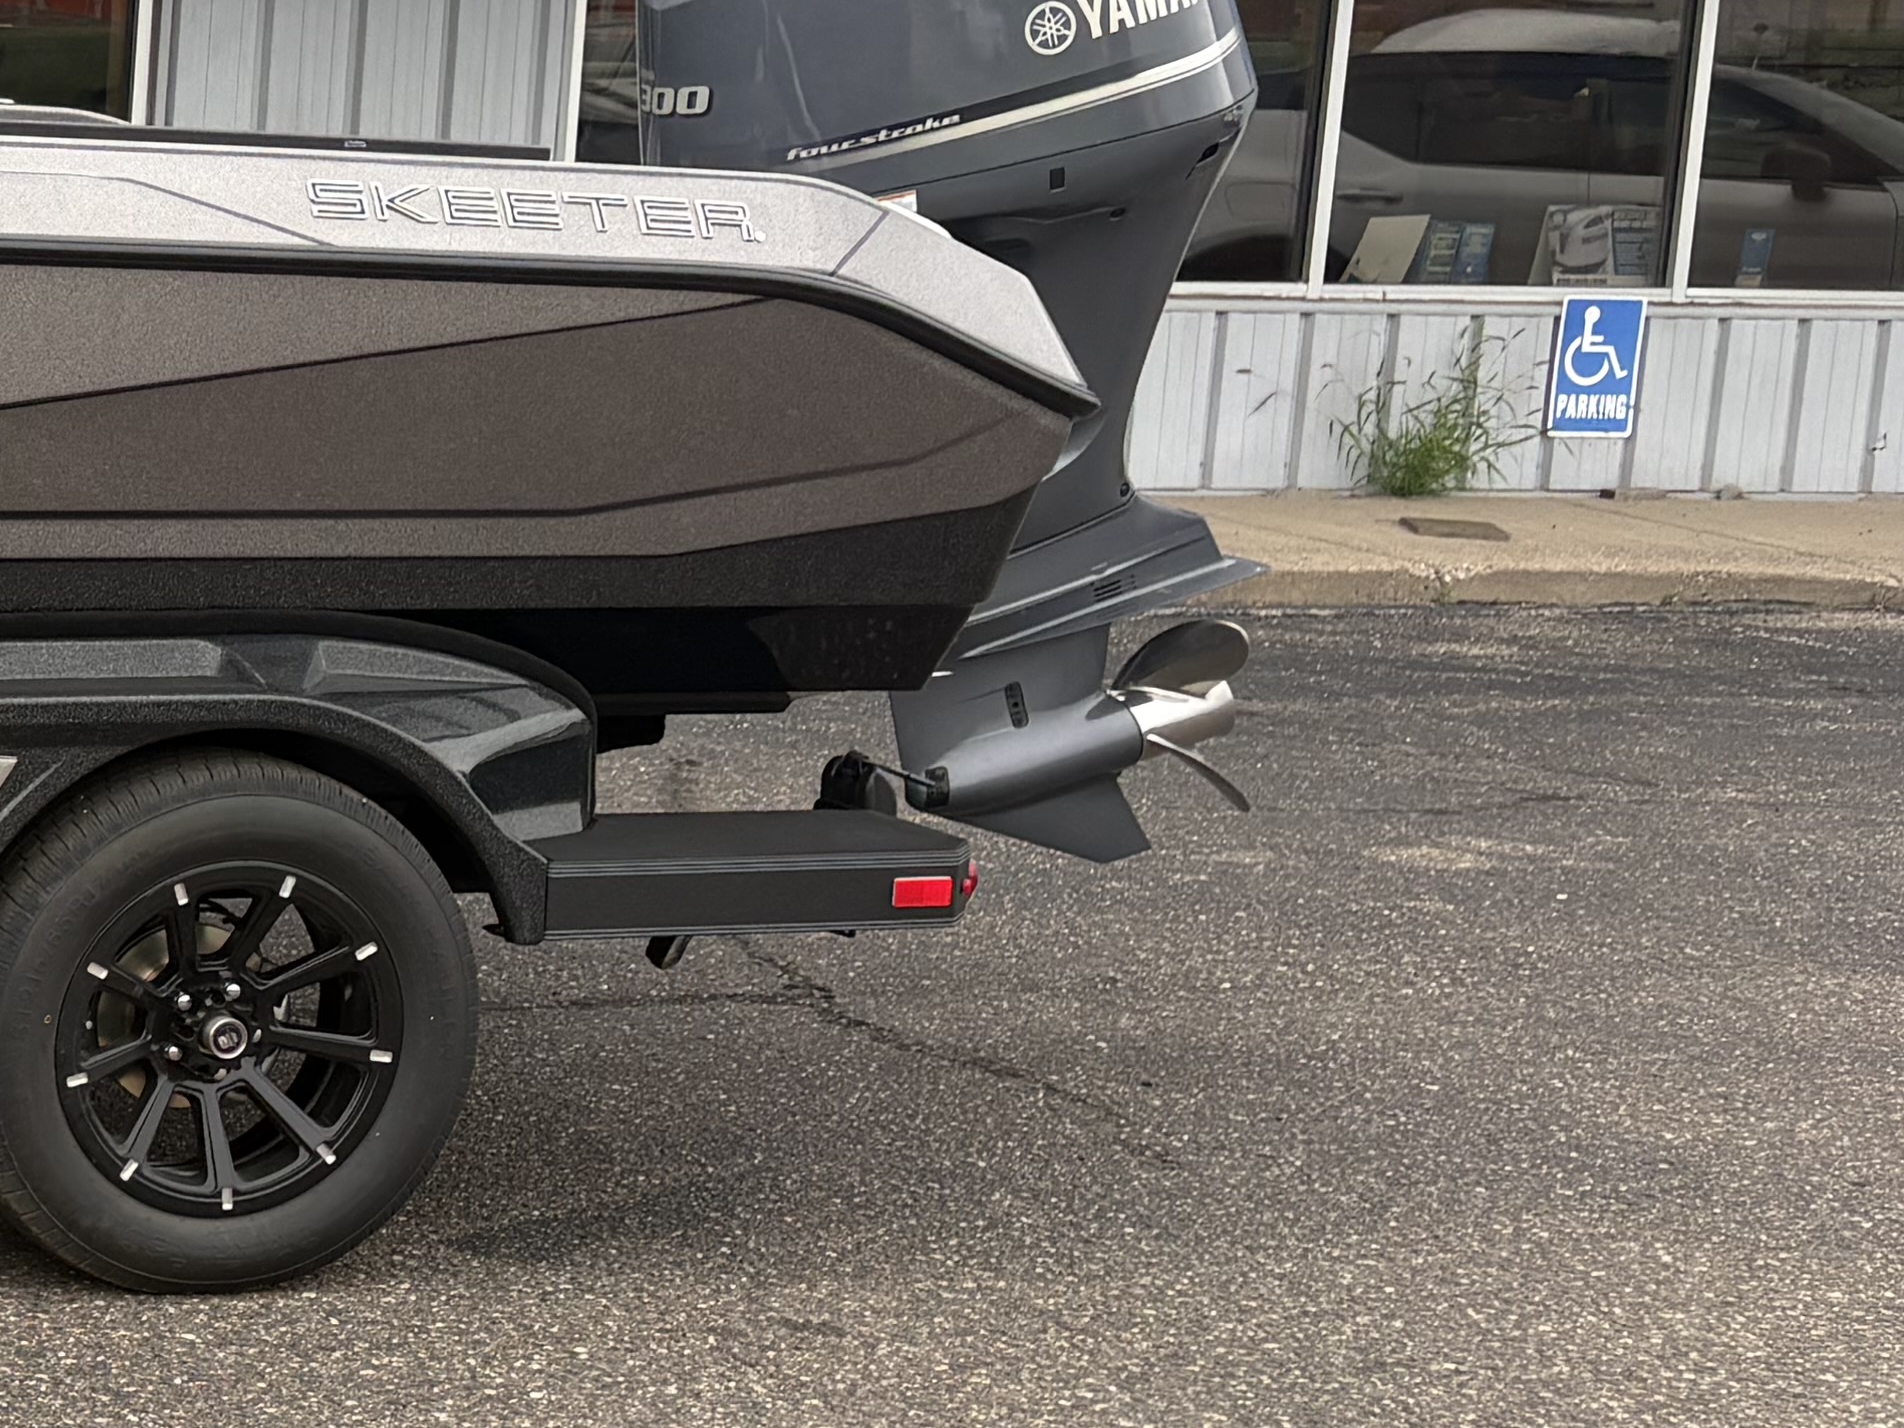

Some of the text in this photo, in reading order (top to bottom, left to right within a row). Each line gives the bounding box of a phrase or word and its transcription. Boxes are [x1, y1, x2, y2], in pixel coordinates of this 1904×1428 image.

[640, 84, 710, 115] 300
[305, 177, 758, 241] SKEETER
[1555, 393, 1628, 420] PARKING
